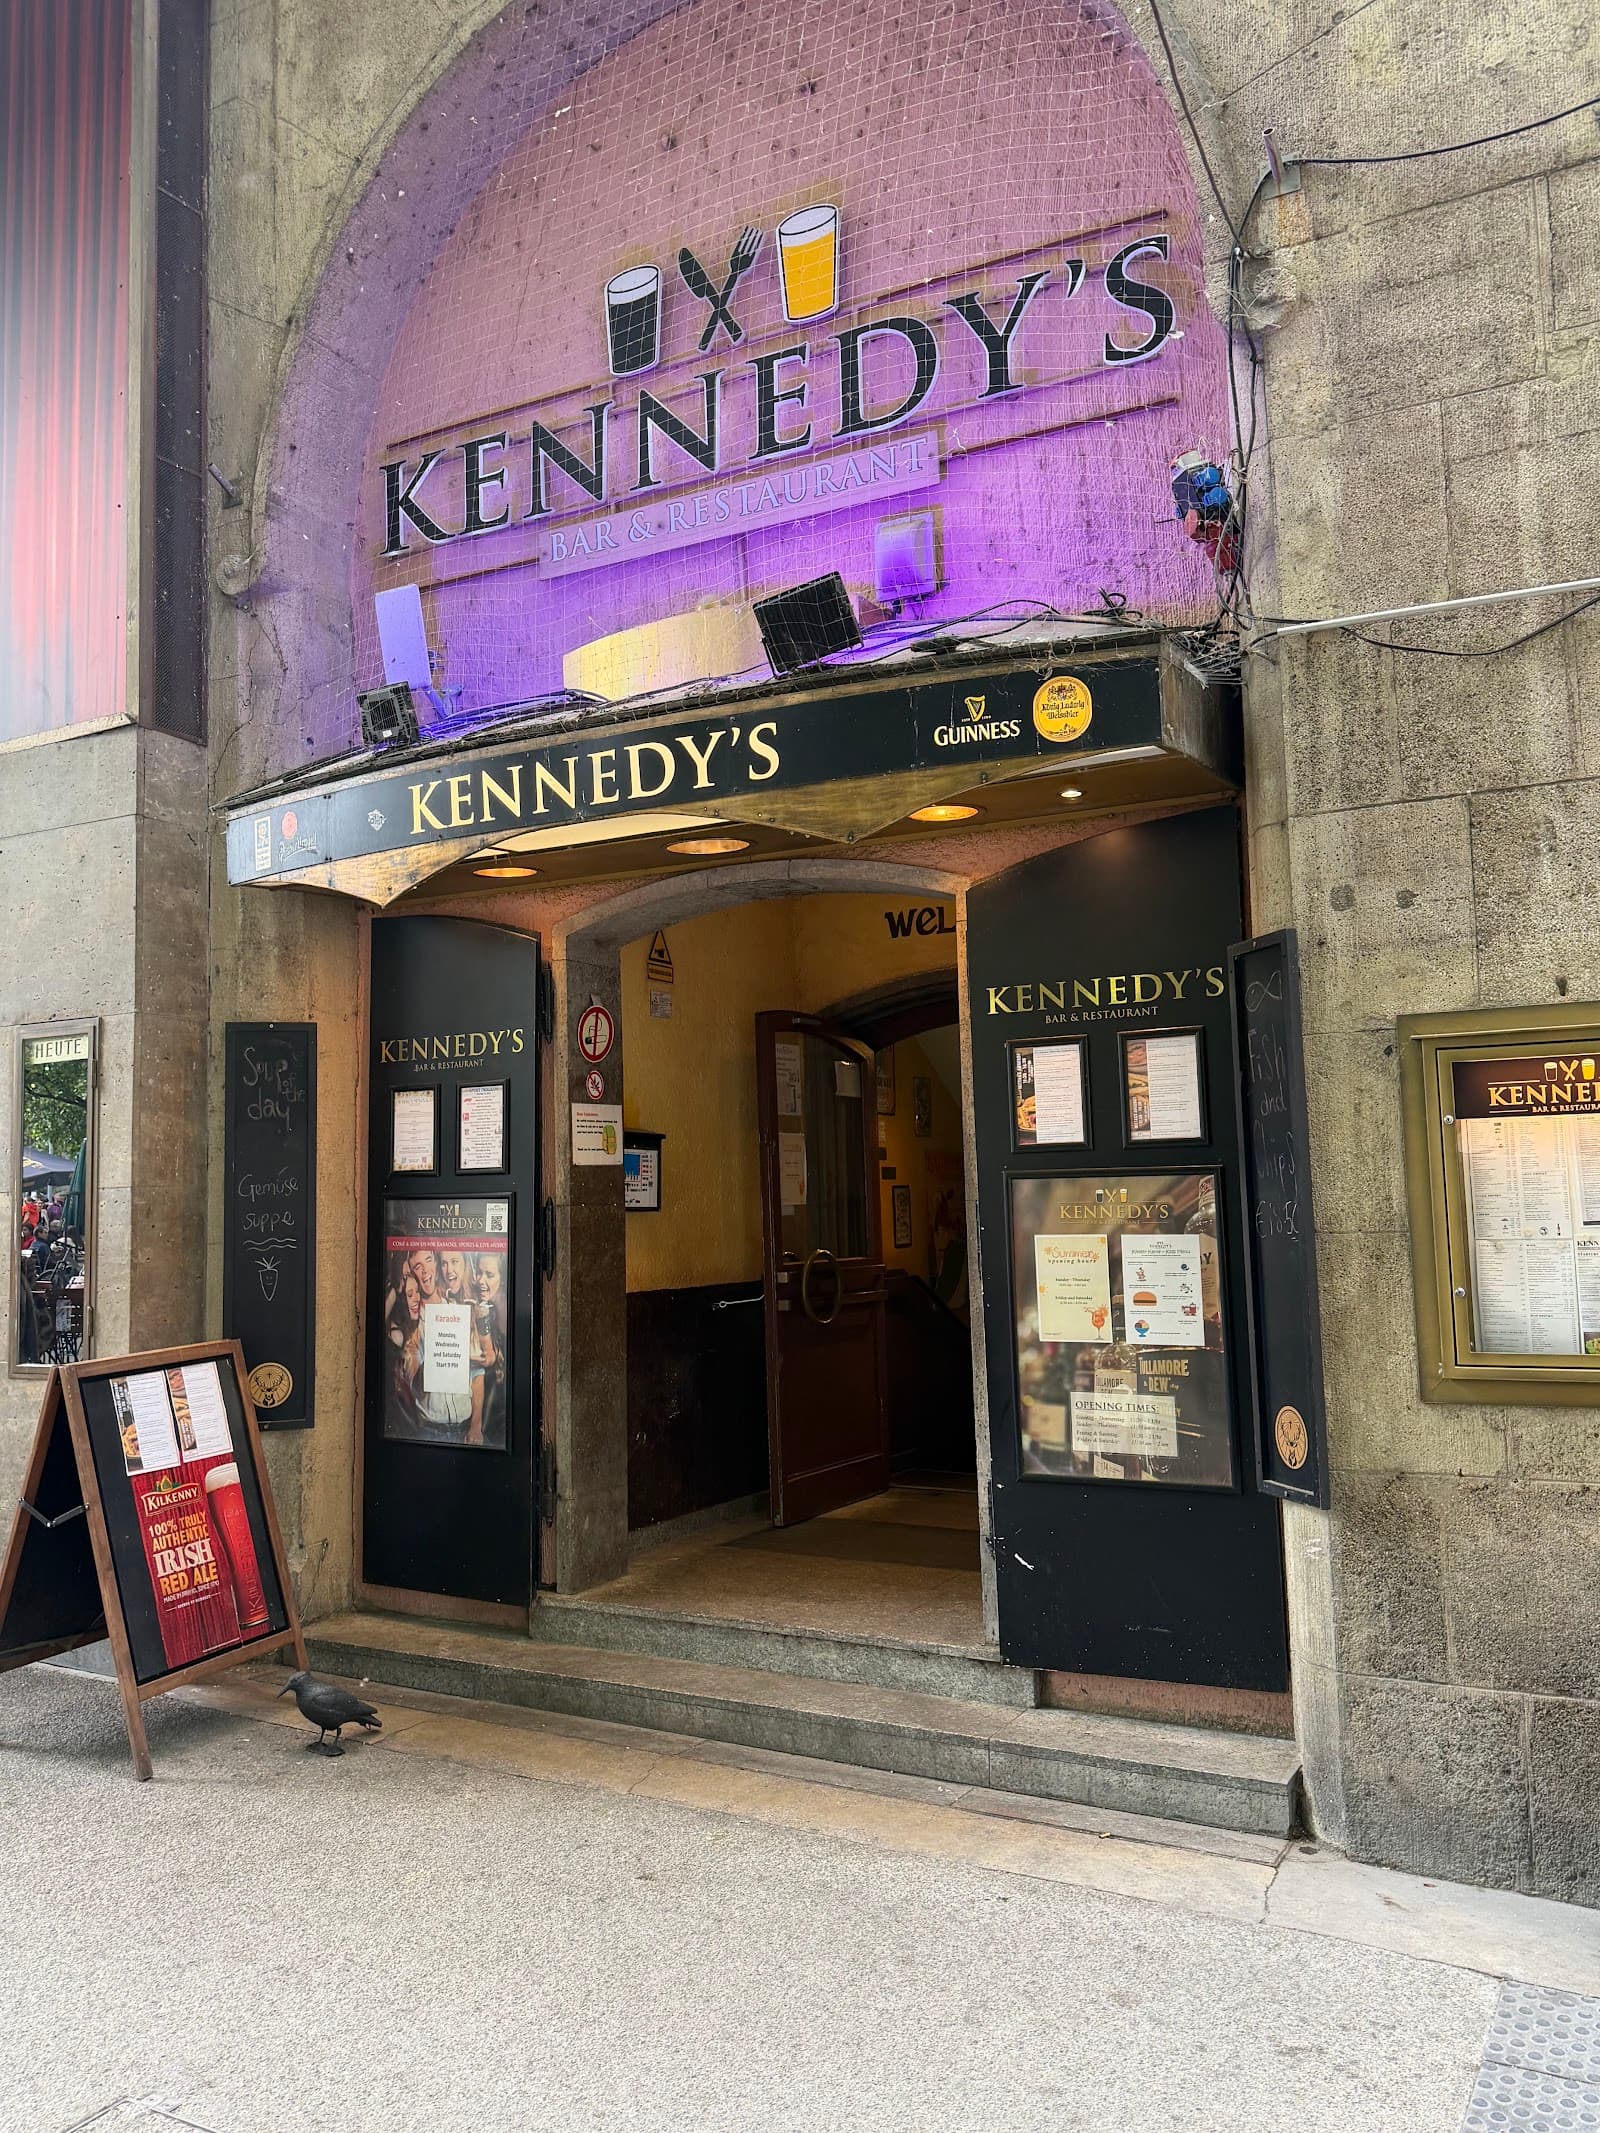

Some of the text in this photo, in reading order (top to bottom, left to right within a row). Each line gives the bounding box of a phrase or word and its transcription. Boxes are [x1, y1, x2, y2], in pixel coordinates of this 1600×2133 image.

[379, 234, 1176, 558] KENNEDY'S
[551, 437, 927, 564] BAR & RESTAURANT
[934, 720, 1021, 746] GUINNESS
[409, 721, 780, 835] KENNEDY'S
[986, 967, 1224, 1015] KENNEDY'S
[1045, 1006, 1158, 1024] BAR & RESTAURANT
[36, 1038, 82, 1059] HEUTE
[380, 1028, 524, 1063] KENNEDY'S
[416, 1064, 428, 1072] BAR
[438, 1059, 484, 1070] RESTAURANT
[247, 1087, 290, 1132] day
[418, 1217, 483, 1229] KENNEDY'S
[1059, 1204, 1168, 1219] KENNEDY'S
[435, 1314, 461, 1323] Karaoke
[1075, 1400, 1122, 1411] OPENING
[1126, 1403, 1159, 1413] TIMES:
[146, 1487, 198, 1511] KILKENNY
[149, 1511, 206, 1538] 100% TRULY
[152, 1524, 209, 1552] AUTHENTIC
[153, 1538, 216, 1578] IRISH
[159, 1572, 189, 1596] RED
[193, 1562, 218, 1587] ALE
